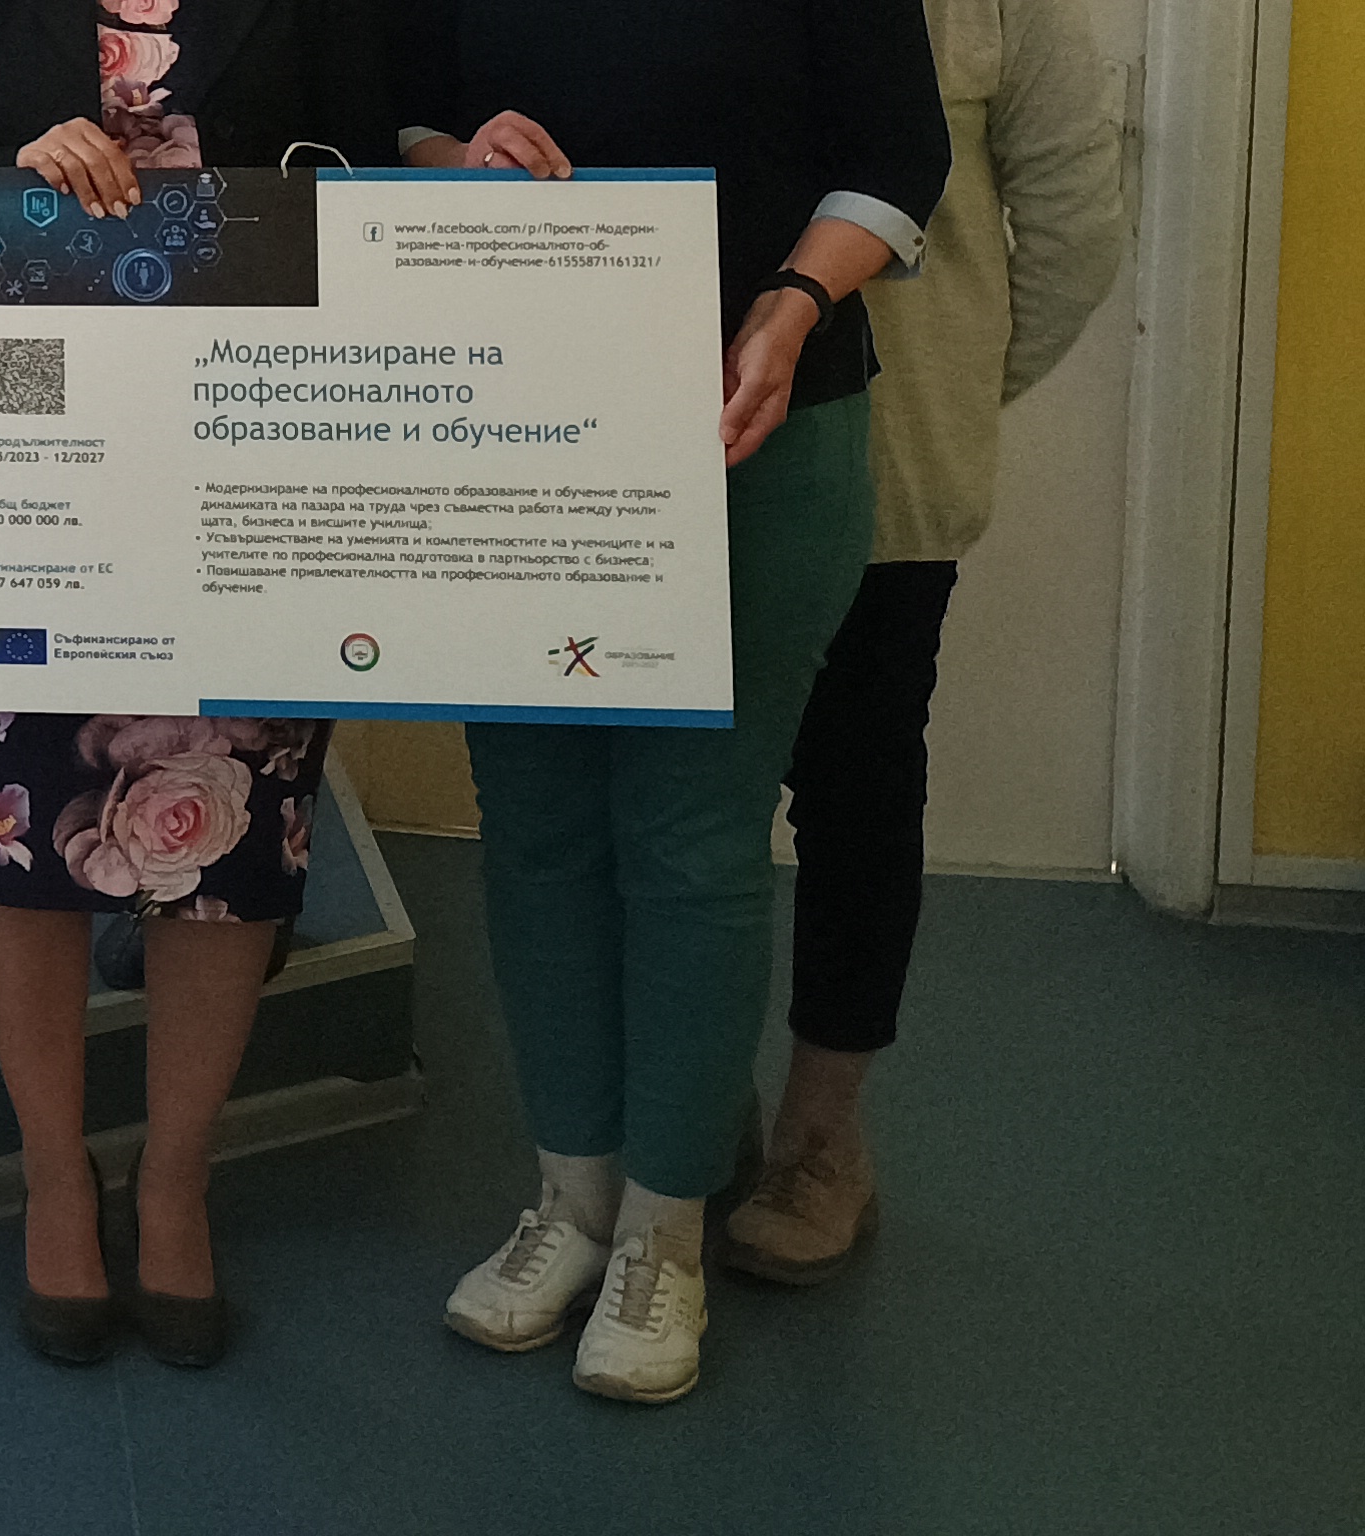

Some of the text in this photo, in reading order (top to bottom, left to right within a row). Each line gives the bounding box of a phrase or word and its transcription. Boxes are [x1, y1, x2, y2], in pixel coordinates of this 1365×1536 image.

[194, 338, 504, 371] „Модернизиране на
[193, 377, 474, 408] професионалното
[193, 414, 598, 449] образование и обучение“
[54, 452, 105, 463] 12/2027
[206, 482, 671, 500] Модернизиране на професионалното образование и обучение спрямо
[21, 498, 71, 511] бюджет
[201, 501, 278, 512] динамиката
[282, 501, 297, 511] на
[301, 502, 345, 512] пазара
[349, 502, 365, 511] на
[370, 503, 406, 513] труда
[410, 503, 440, 514] чрез
[444, 503, 514, 514] съвместна
[519, 502, 563, 515] работа
[568, 505, 612, 517] между
[8, 514, 32, 525] 000
[35, 514, 59, 525] 000
[63, 517, 83, 526] лв.
[201, 517, 237, 528] щата,
[242, 515, 294, 527] бизнеса
[298, 518, 306, 527] и
[310, 518, 367, 528] висшите
[206, 533, 675, 551] Усъвършенстване на уменията и компетентностите на учениците и на
[201, 550, 268, 561] учителите
[272, 551, 288, 560] по
[291, 550, 395, 563] професионална
[399, 552, 473, 564] подготовка
[489, 554, 579, 566] партньорство
[80, 565, 94, 573] от
[98, 563, 113, 573] ЕС
[206, 565, 287, 577] Повишаване
[290, 567, 417, 579] привлекателността
[422, 570, 437, 580] на
[441, 568, 561, 583] професионалното
[565, 570, 651, 583] образование
[10, 577, 33, 588] 647
[37, 578, 60, 589] 059
[64, 580, 85, 589] лв.
[54, 633, 175, 646] Съфинансирано от
[54, 648, 174, 661] Европейския съюз
